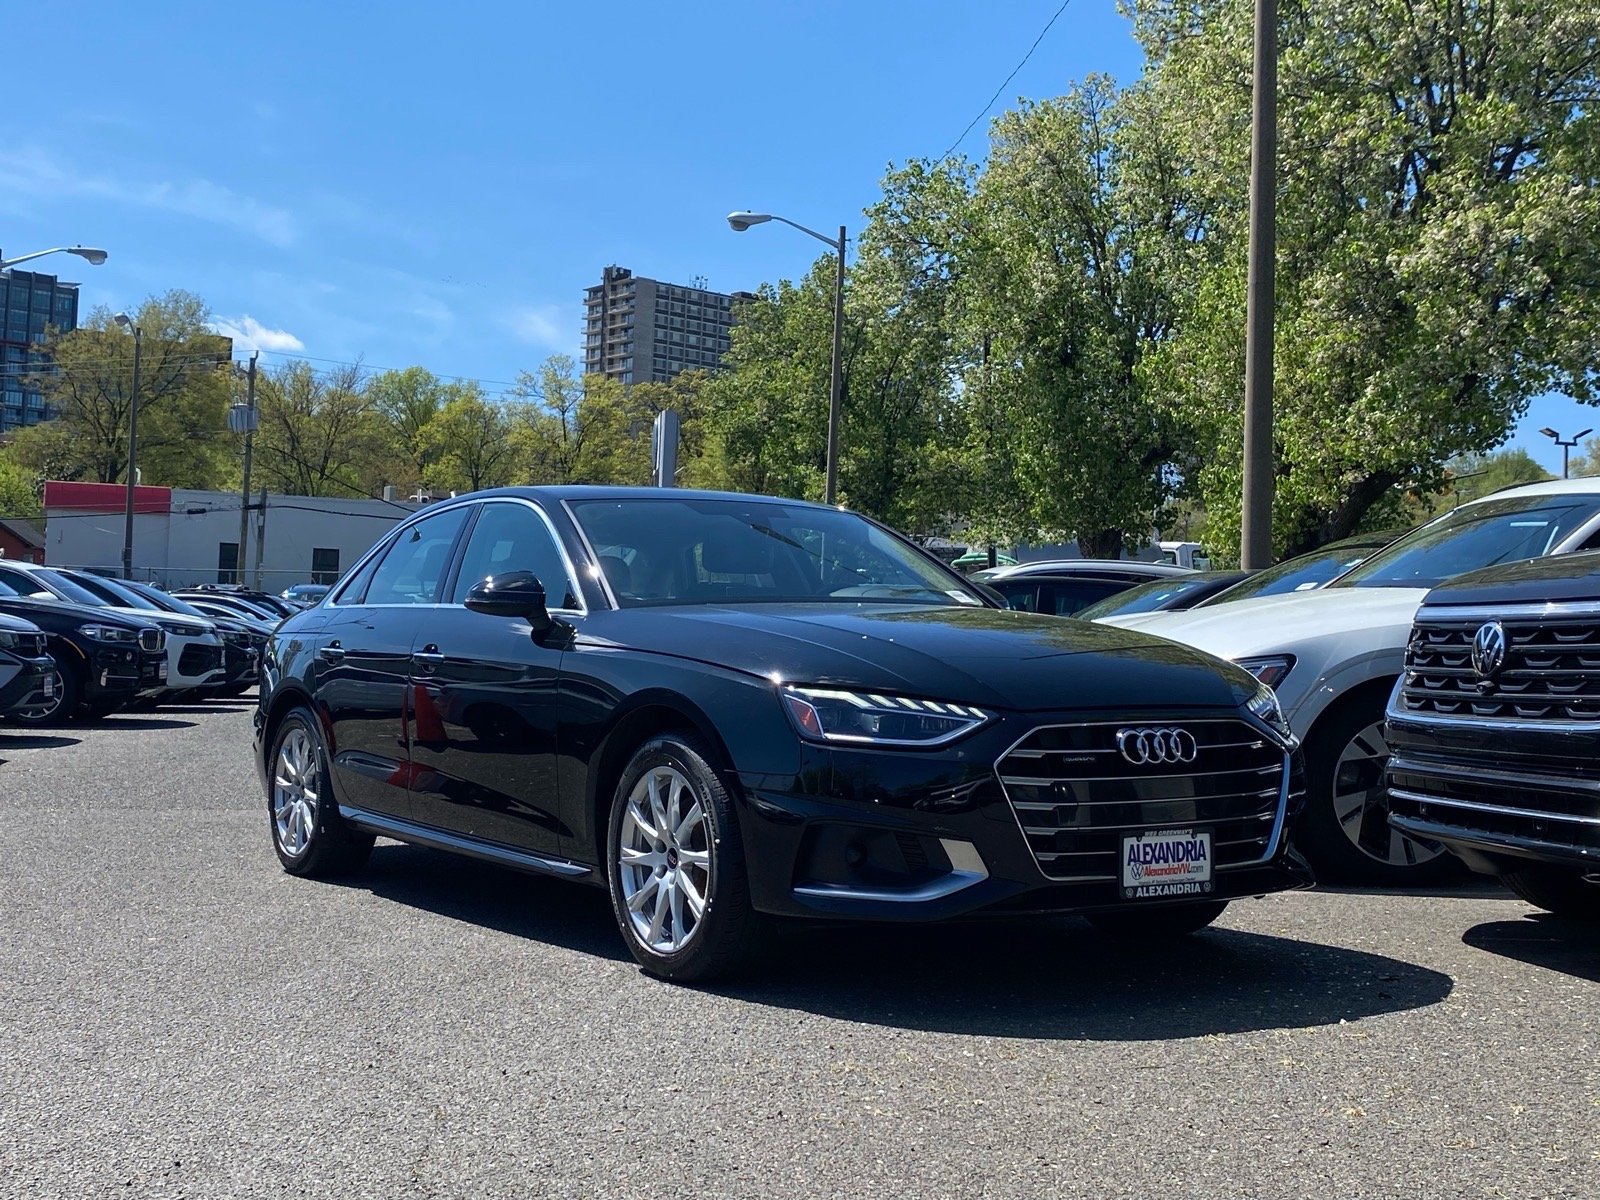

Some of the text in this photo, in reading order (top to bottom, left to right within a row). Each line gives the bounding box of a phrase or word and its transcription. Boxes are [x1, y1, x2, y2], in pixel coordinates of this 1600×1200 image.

[1127, 840, 1207, 866] ALEXANDRIA
[1143, 863, 1204, 877] AlexandriaVW.com
[1136, 883, 1201, 897] ALEXANDRIA
